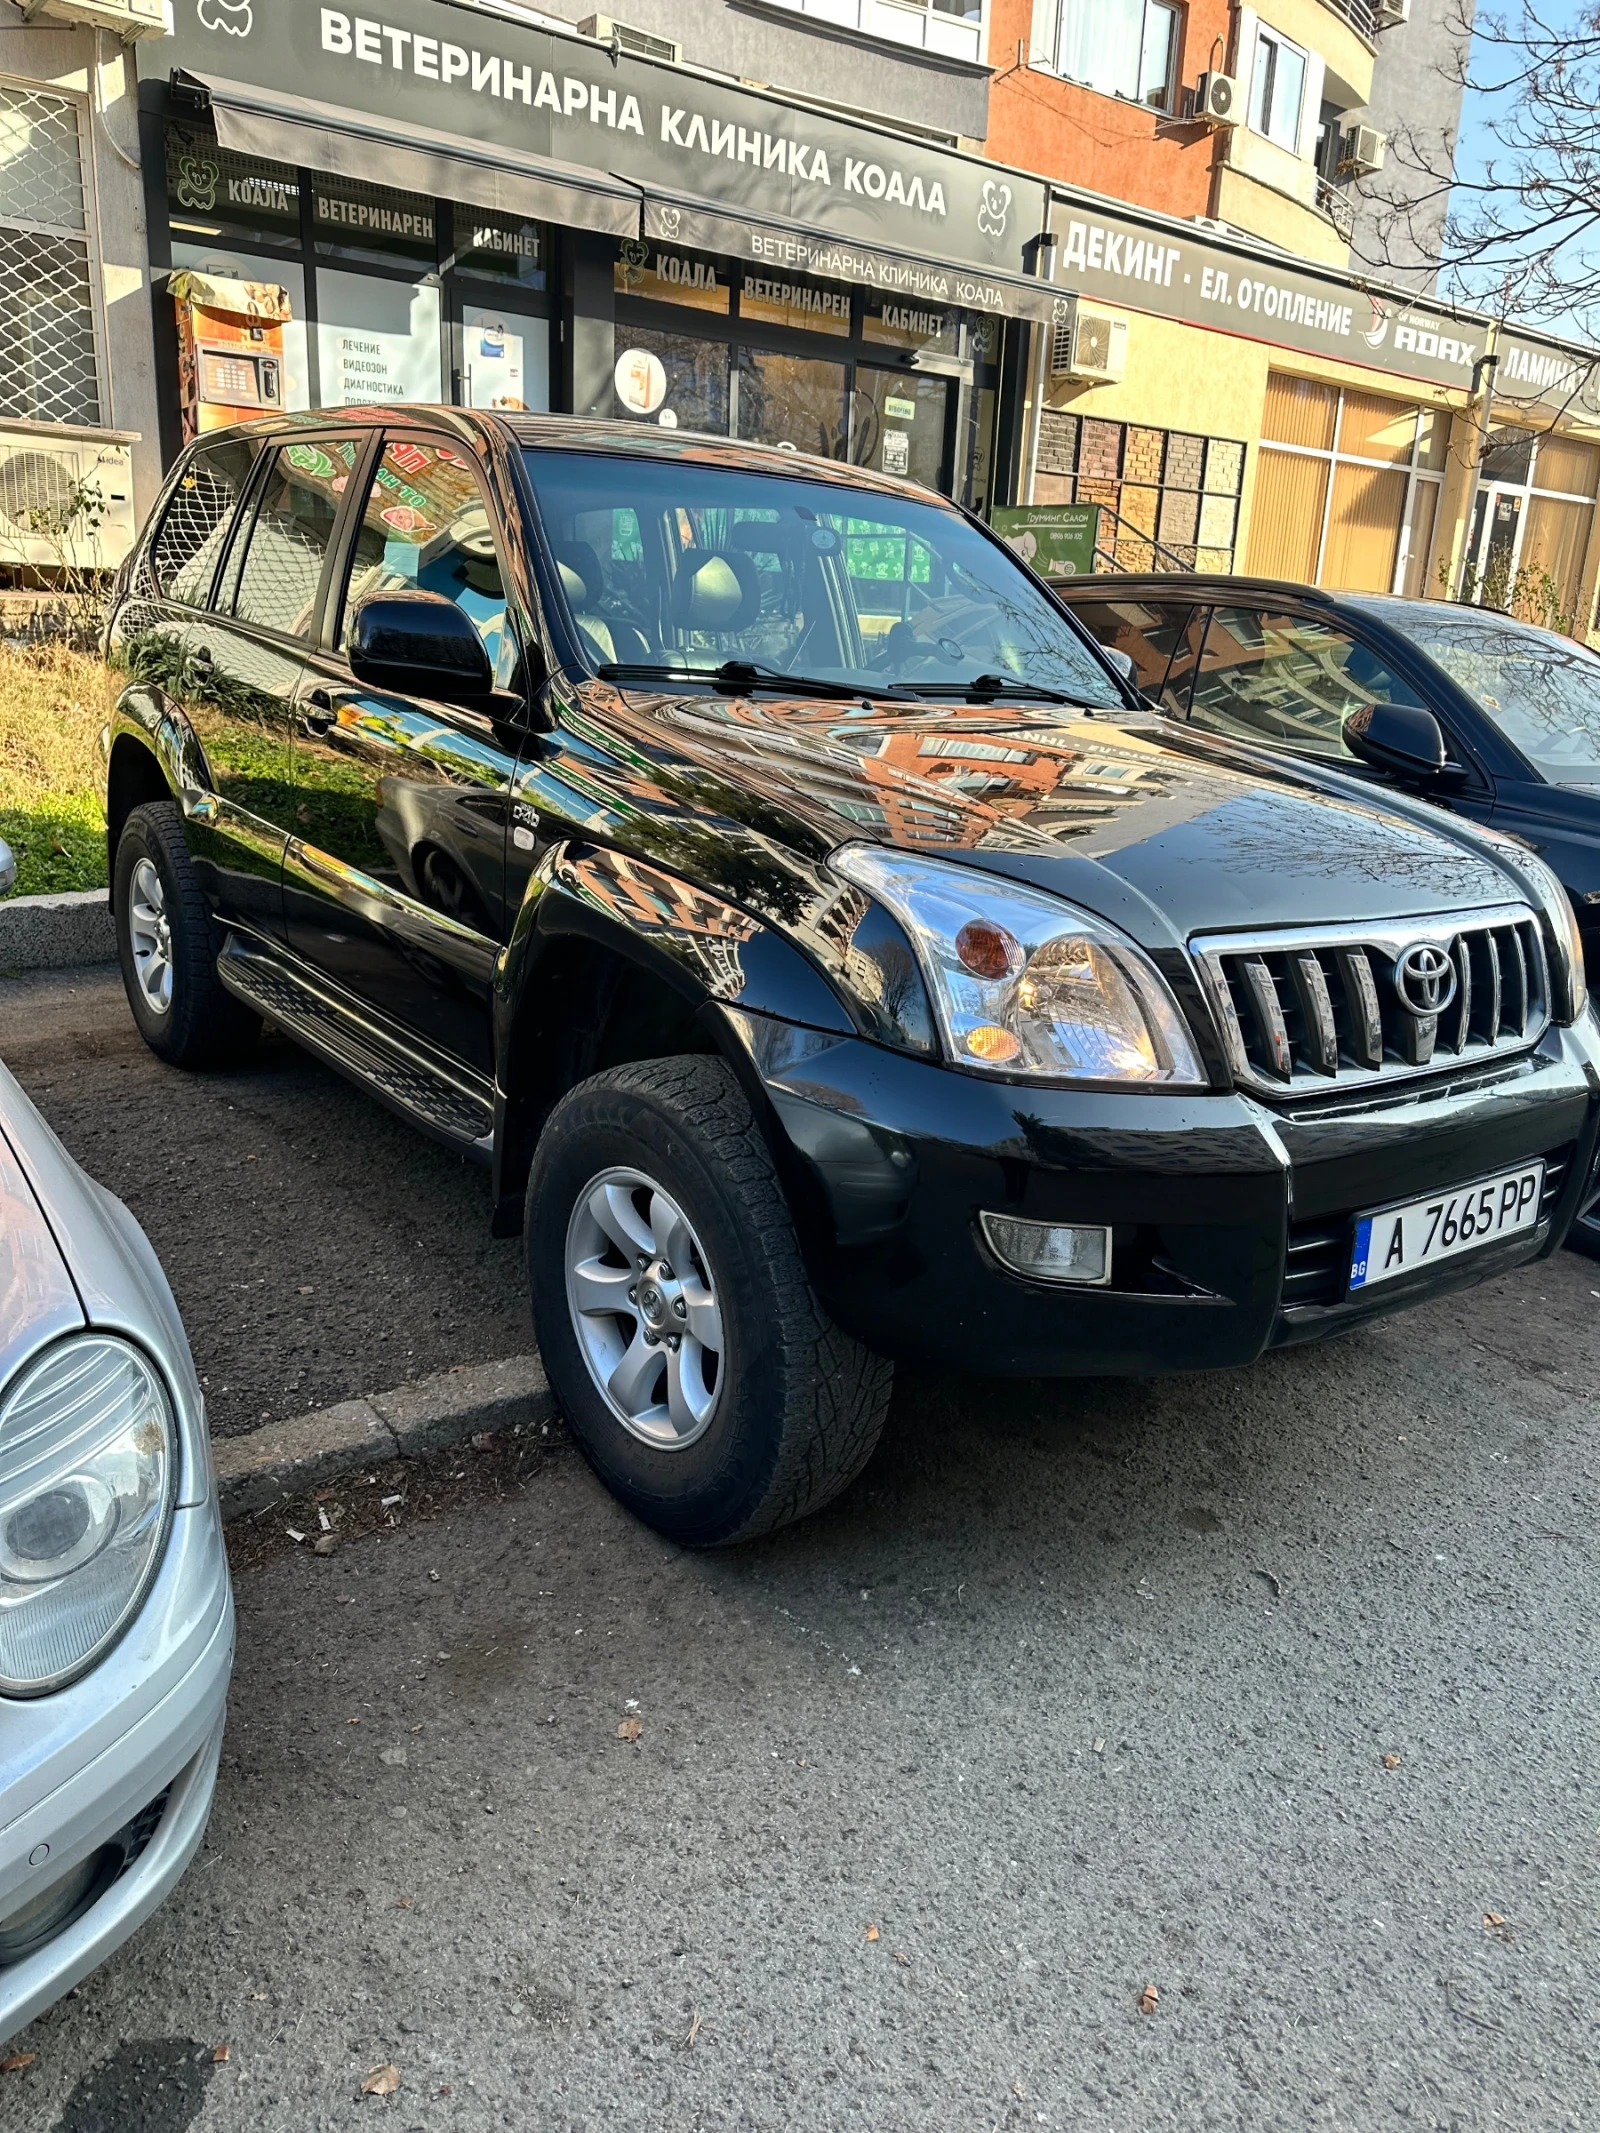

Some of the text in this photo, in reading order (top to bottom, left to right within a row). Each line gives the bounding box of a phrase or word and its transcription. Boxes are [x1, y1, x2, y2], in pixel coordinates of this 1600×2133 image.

[320, 8, 946, 216] ВЕТЕРИНАРНА КЛИНИКА КОАЛА
[228, 179, 540, 258] КОАЛА ВЕТЕРИНАРЕН КАБИНЕТ
[751, 236, 1004, 307] ВЕТЕРИНАРНА КЛИНИКА КОАЛА
[1062, 220, 1353, 336] ДЕКИНГ ЕЛ. ОТОПЛЕНИЕ
[656, 254, 943, 338] КОАЛА ВЕТЕРИНАРЕН КАБИНЕТ
[1394, 325, 1477, 368] ADAX
[1409, 314, 1440, 331] NORWAY
[342, 339, 381, 355] ЛЕЧЕНИЕ
[343, 358, 388, 375] ВИДЕОЗОН
[343, 377, 404, 396] ДИАГНОСТИКА
[1384, 1216, 1403, 1269] A
[1351, 1261, 1366, 1279] BG
